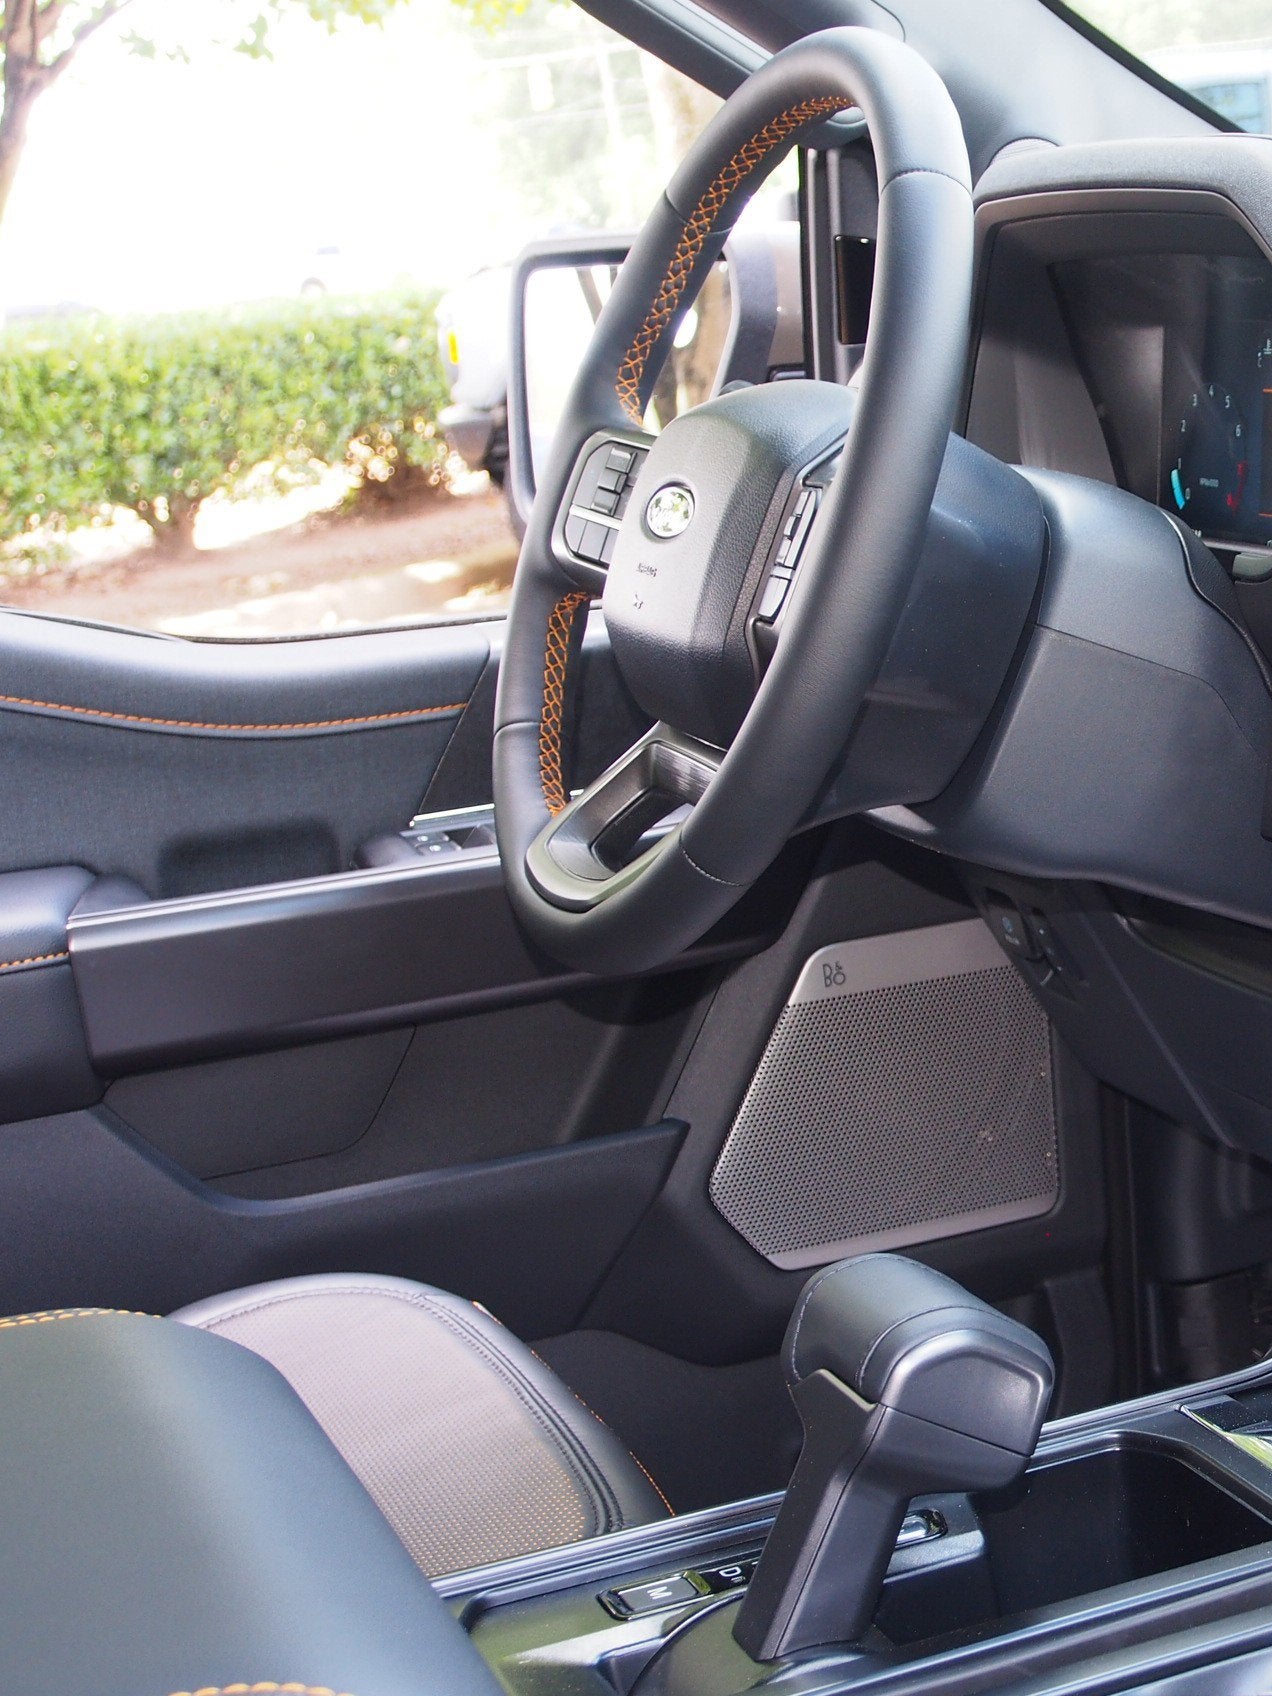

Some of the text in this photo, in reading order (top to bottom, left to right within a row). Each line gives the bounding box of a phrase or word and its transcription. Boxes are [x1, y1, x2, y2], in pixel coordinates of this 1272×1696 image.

[1192, 393, 1198, 407] 3
[1225, 395, 1230, 408] 5
[1181, 419, 1186, 432] 2
[647, 1586, 673, 1600] M
